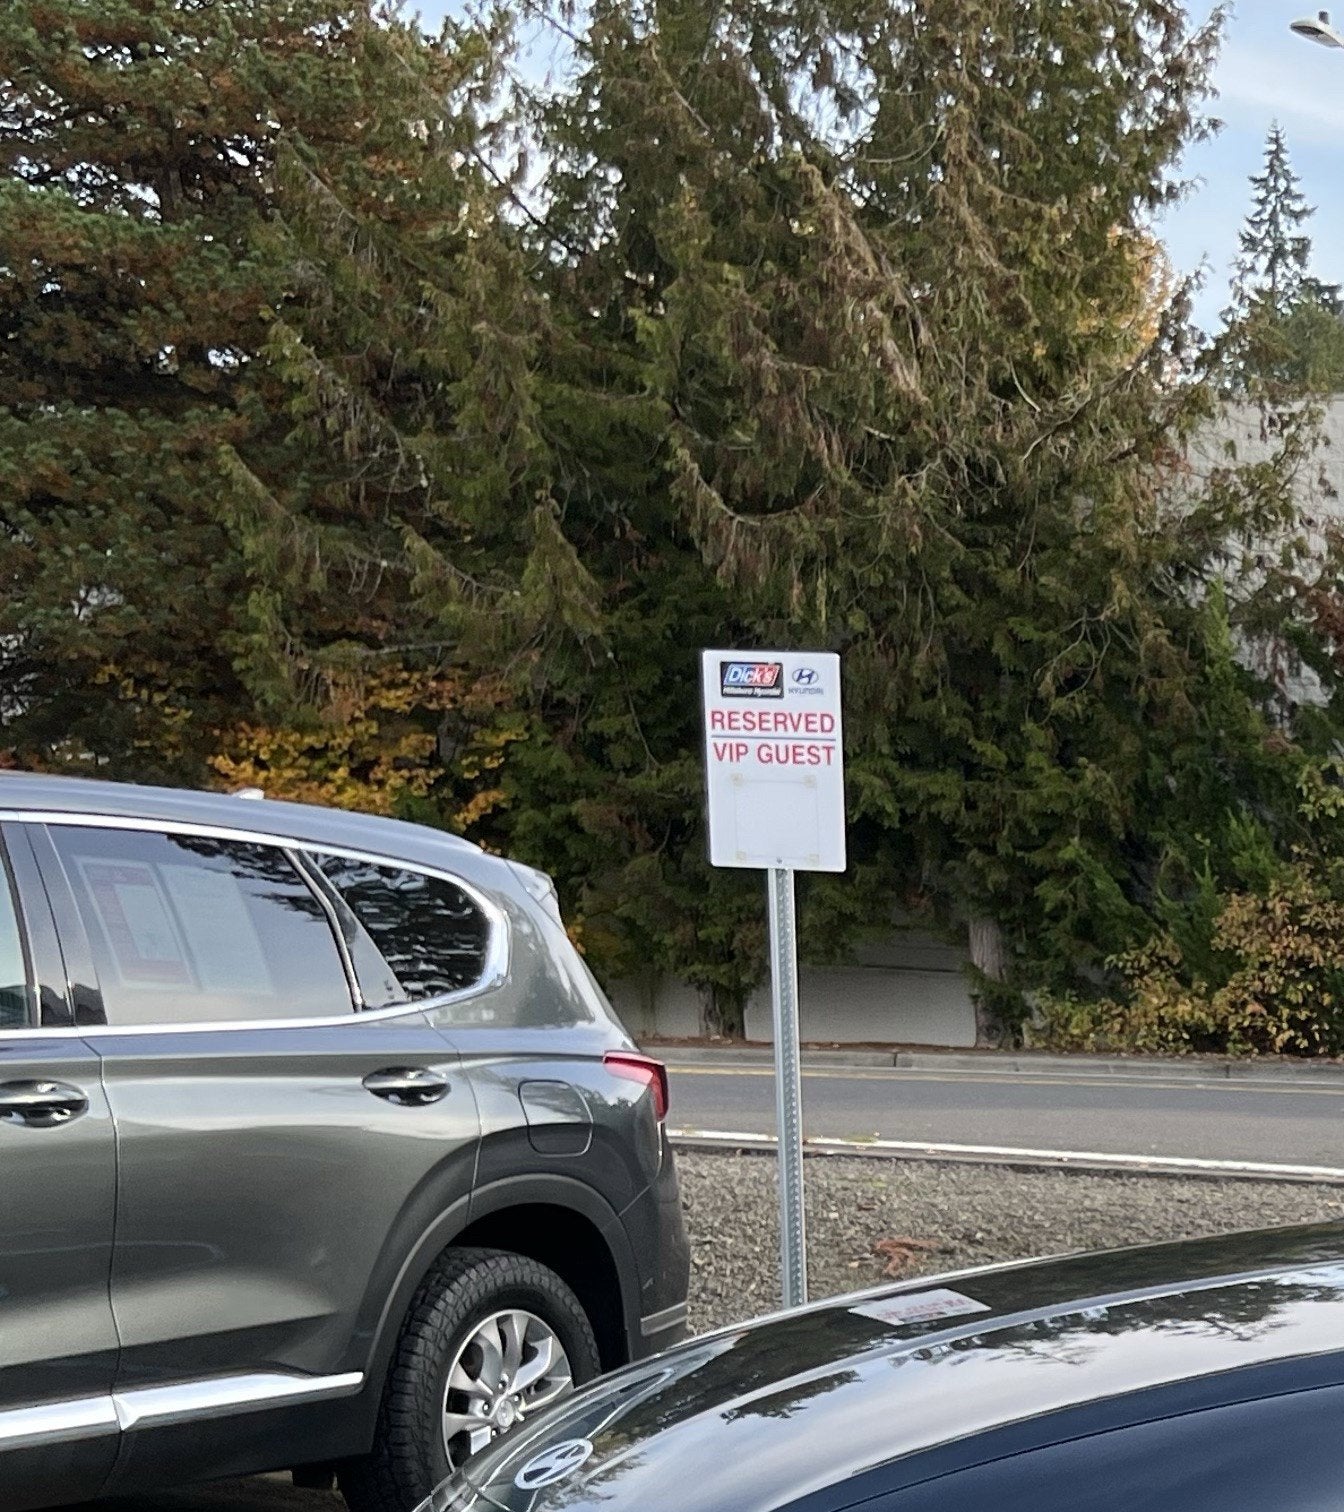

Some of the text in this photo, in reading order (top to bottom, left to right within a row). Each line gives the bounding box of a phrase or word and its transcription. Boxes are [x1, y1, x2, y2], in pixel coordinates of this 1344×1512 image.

[711, 710, 835, 733] RESERVED
[713, 742, 836, 766] VIP GUEST
